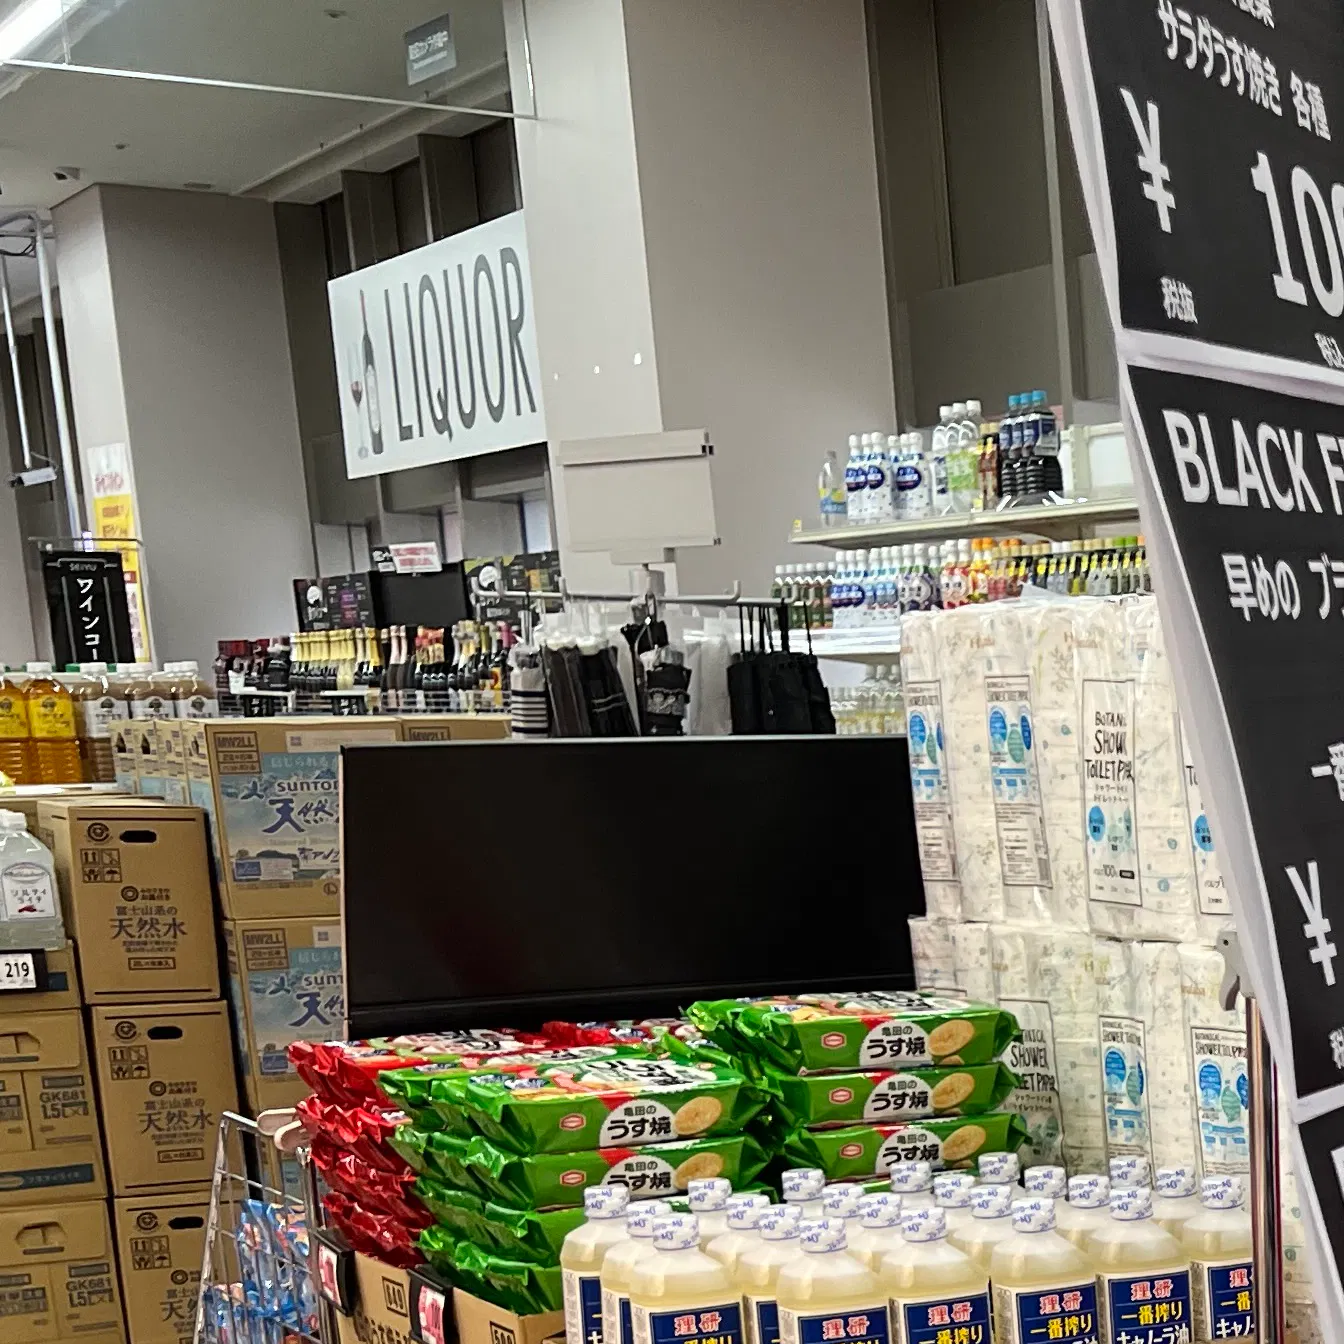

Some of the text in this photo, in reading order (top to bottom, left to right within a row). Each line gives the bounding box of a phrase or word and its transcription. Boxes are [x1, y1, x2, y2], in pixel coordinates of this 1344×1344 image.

[1158, 0, 1332, 142] サラダうす焼き 各種
[1120, 88, 1176, 233] ¥
[1160, 277, 1198, 325] 税抜
[383, 246, 537, 443] LIQUOR
[1160, 407, 1323, 514] BLACK
[1220, 552, 1301, 621] 早めの
[110, 917, 188, 941] 天然水
[1284, 858, 1339, 987] ¥
[5, 962, 29, 978] 219
[867, 1036, 927, 1059] うす焼
[871, 1089, 929, 1111] うす焼
[138, 1109, 215, 1136] 天然水
[607, 1117, 672, 1141] うす焼
[1130, 1279, 1173, 1301] 理研
[927, 1303, 973, 1326] 理研
[1039, 1292, 1082, 1315] 理研
[1121, 1301, 1183, 1326] 一番搾り
[674, 1312, 722, 1337] 理研
[822, 1316, 870, 1340] 理研
[1030, 1314, 1093, 1340] 一番搾り
